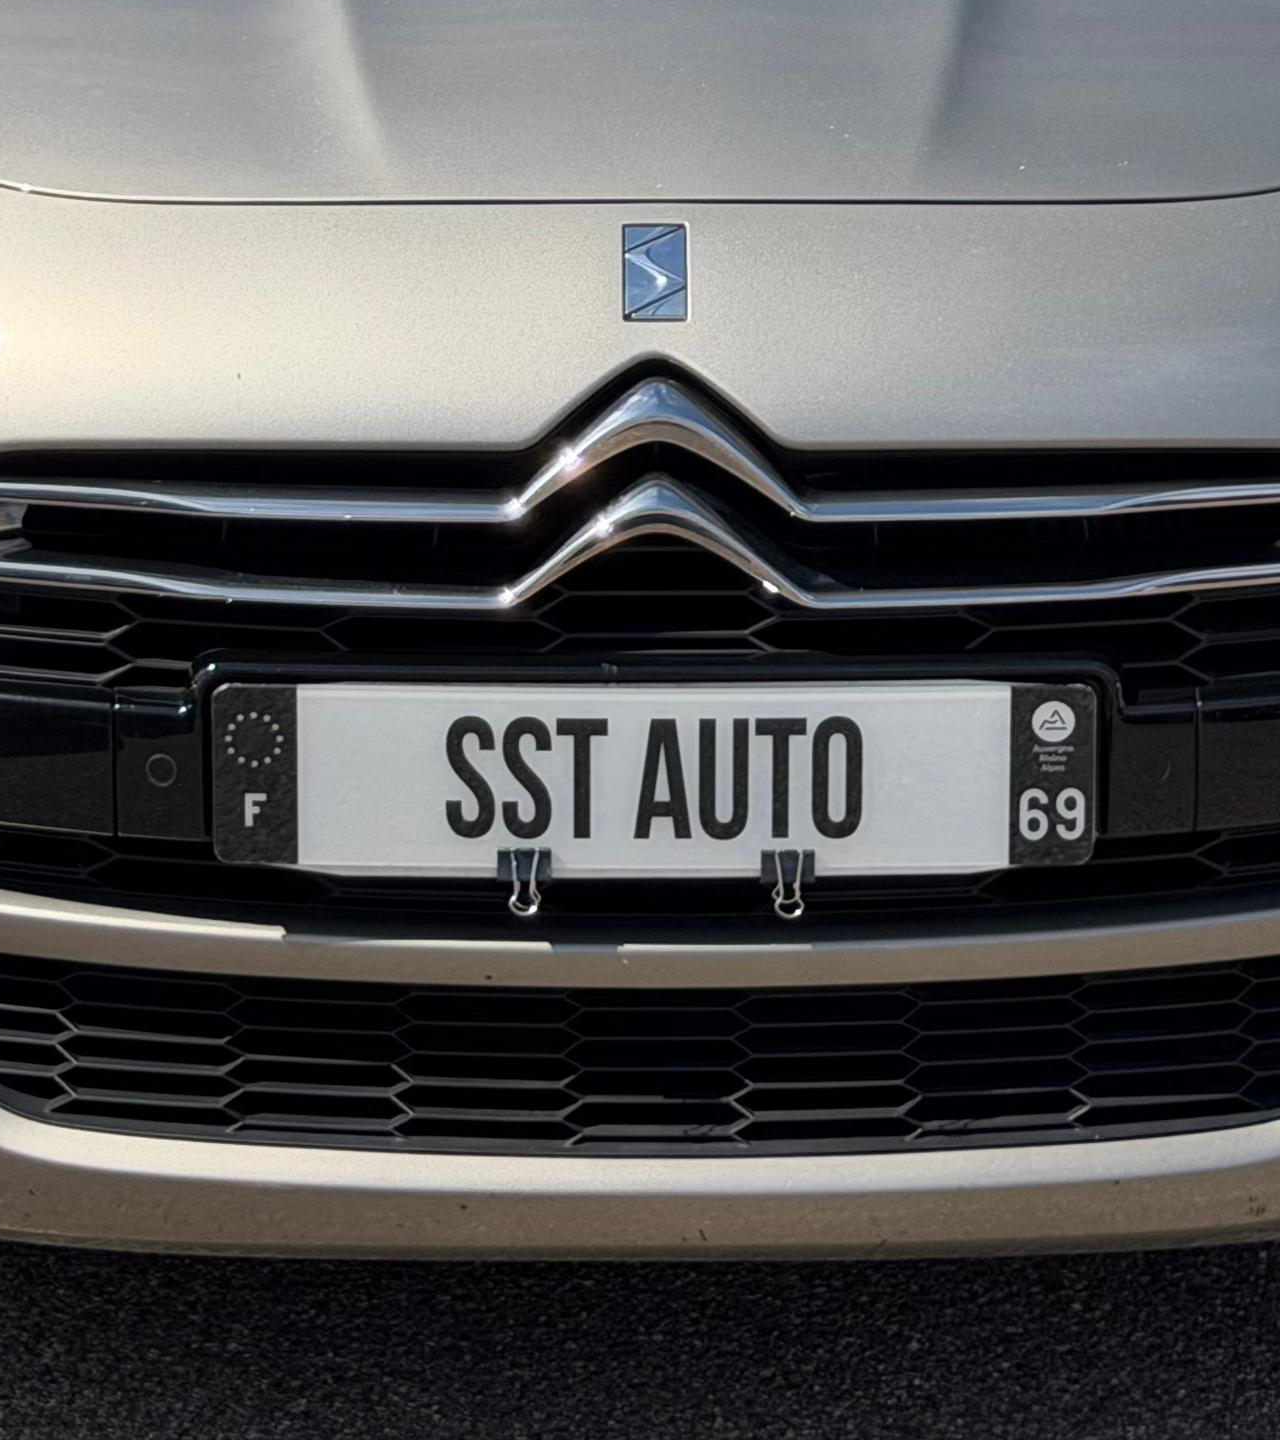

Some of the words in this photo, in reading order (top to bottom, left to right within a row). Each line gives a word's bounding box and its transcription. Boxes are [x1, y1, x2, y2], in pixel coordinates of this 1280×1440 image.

[445, 715, 609, 840] SST
[633, 715, 864, 841] AUTO
[244, 792, 268, 828] F
[1018, 786, 1086, 841] 69
